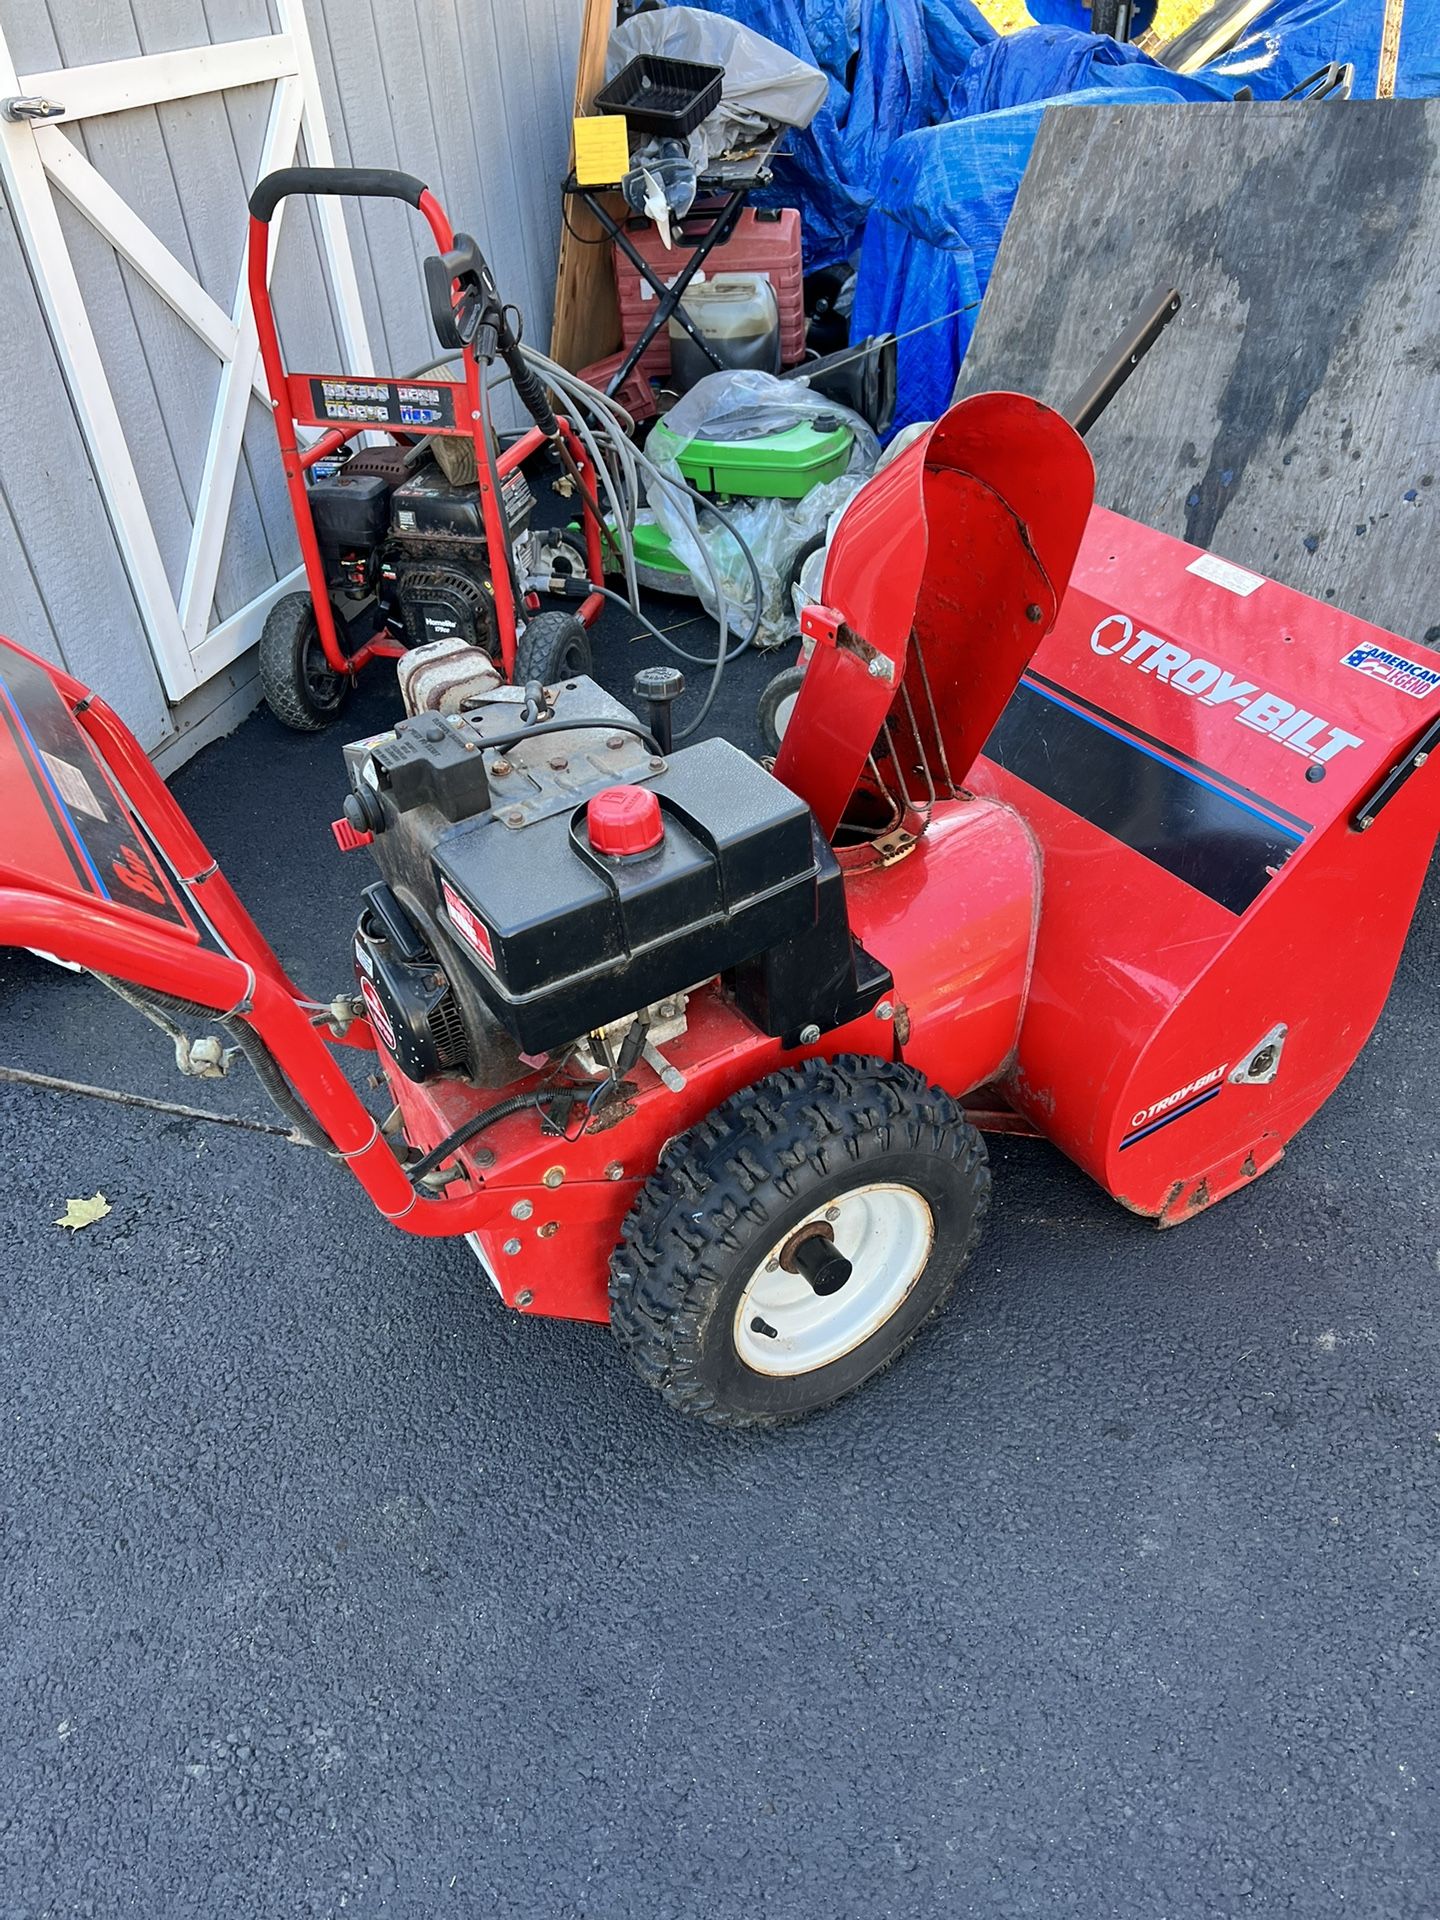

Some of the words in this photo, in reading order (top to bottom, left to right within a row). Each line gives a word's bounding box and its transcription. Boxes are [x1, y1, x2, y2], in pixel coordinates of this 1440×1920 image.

[1364, 647, 1440, 685] AMERICAN
[1385, 668, 1431, 695] LEGEND
[1119, 629, 1365, 765] TROY-BILT
[1147, 1063, 1229, 1118] TROY-BILT
